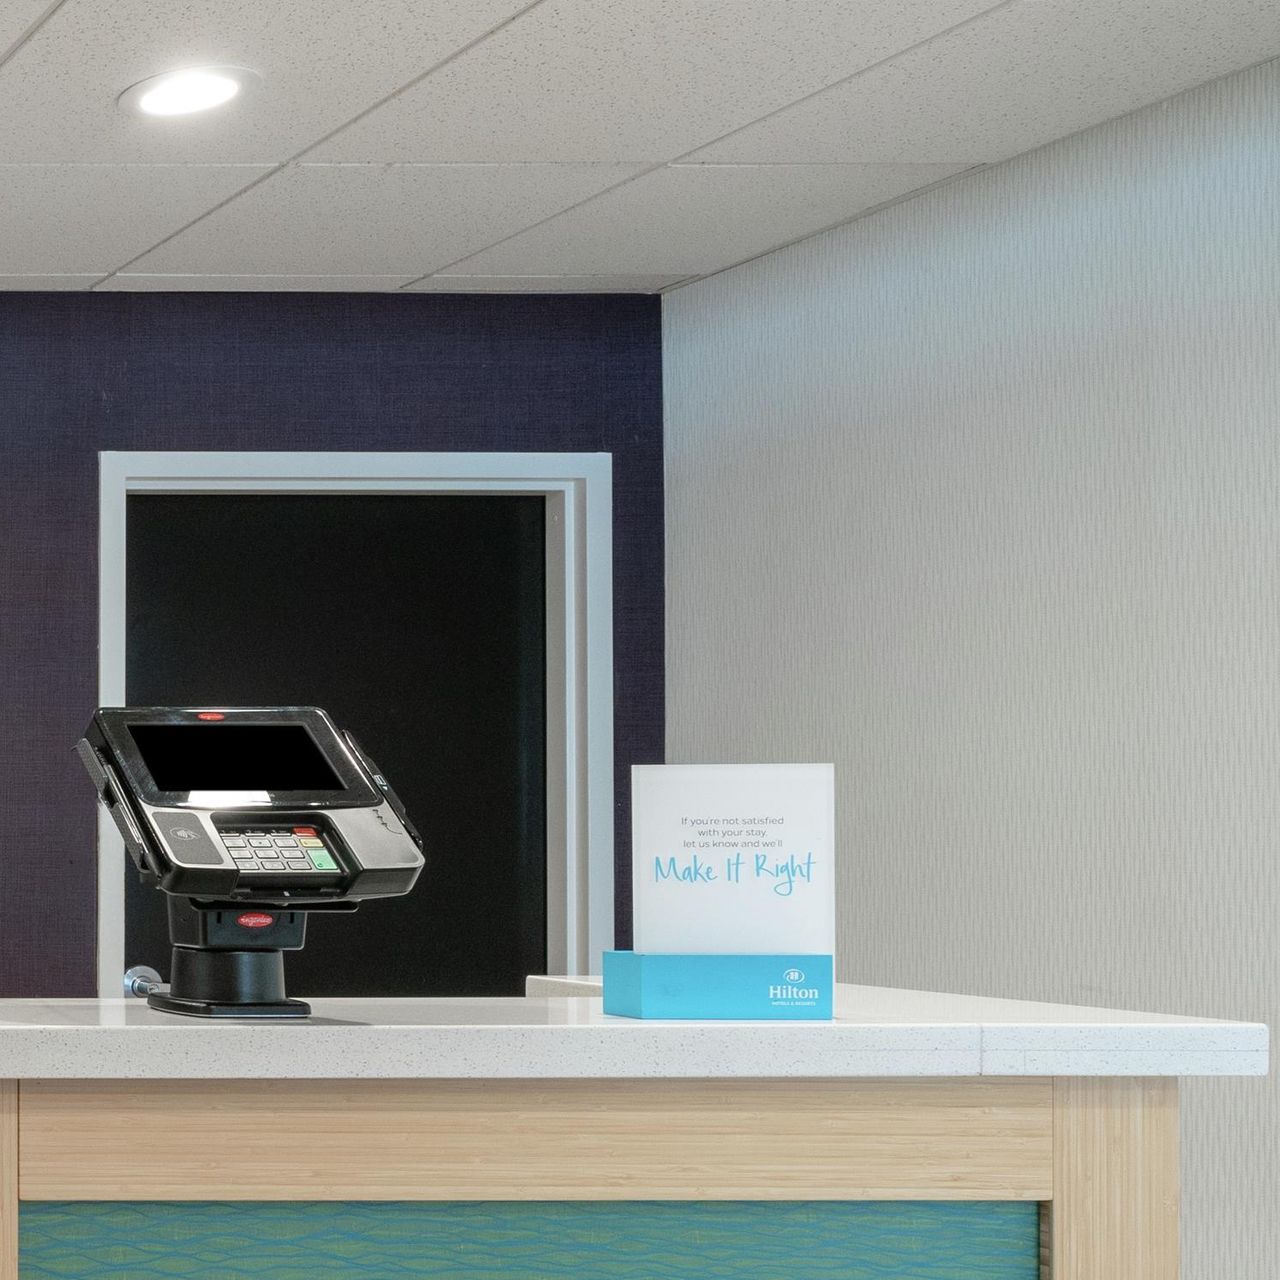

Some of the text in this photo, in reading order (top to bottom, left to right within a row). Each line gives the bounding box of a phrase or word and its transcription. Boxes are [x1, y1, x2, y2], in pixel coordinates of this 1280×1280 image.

[681, 816, 784, 827] If you're not satisfied
[698, 828, 719, 836] with
[721, 829, 743, 838] your
[683, 840, 696, 848] let
[712, 840, 738, 848] know
[741, 840, 759, 848] and
[762, 840, 783, 848] we'll
[655, 852, 817, 896] Make It Right
[769, 985, 819, 999] Hilton
